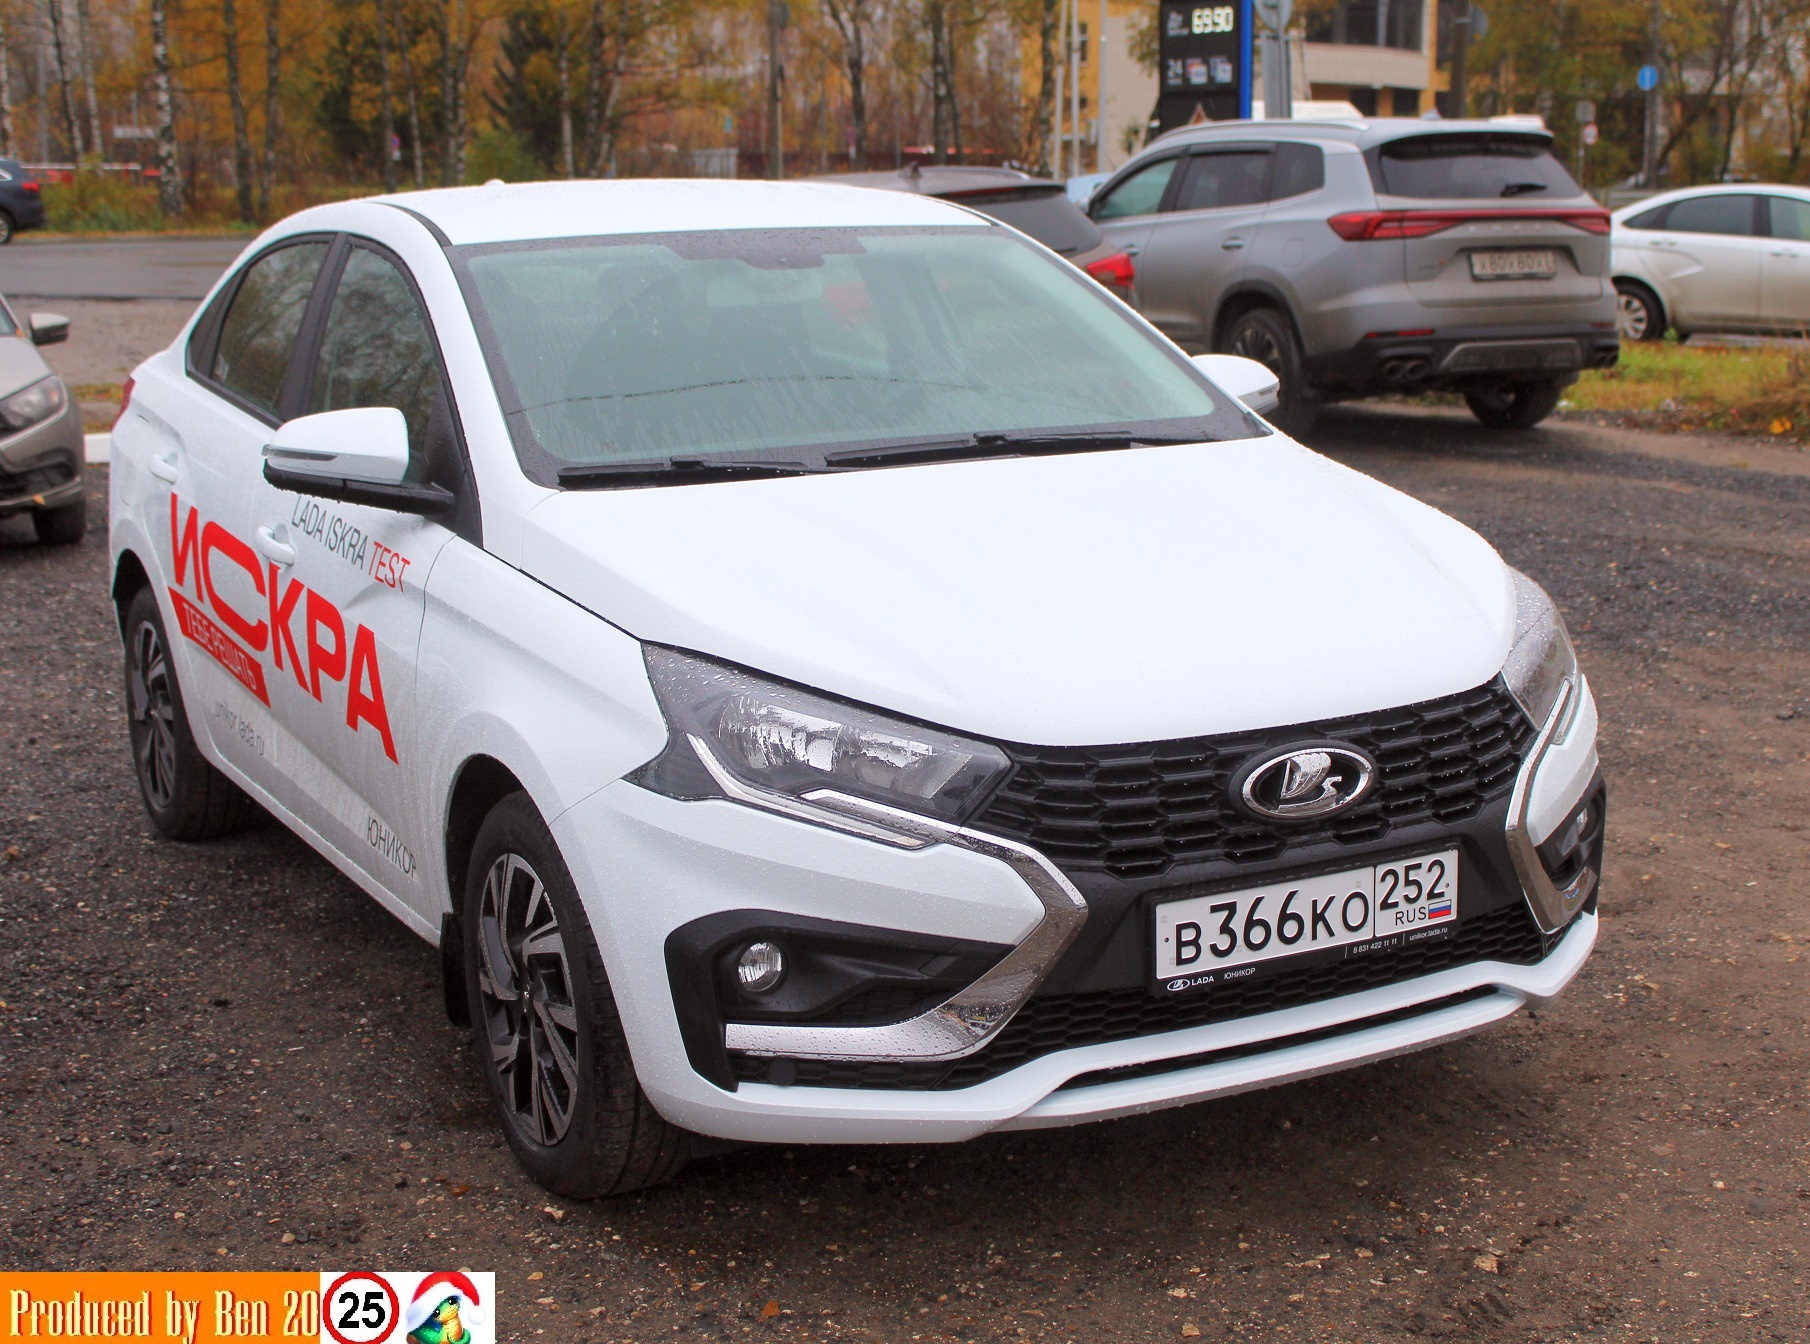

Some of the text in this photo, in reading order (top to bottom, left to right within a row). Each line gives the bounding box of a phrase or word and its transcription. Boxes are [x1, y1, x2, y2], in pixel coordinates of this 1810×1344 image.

[291, 495, 411, 593] LADA ISKRA TEST
[170, 492, 399, 766] ИСКРА
[182, 602, 257, 690] ТЕБЕ РЕШАТЬ
[367, 816, 417, 878] ЮНИКОР
[1379, 859, 1446, 911] 252
[1358, 944, 1369, 953] 831
[1370, 941, 1382, 950] 422
[1409, 927, 1448, 941] unikor.lada.ru
[1394, 907, 1427, 926] RUS
[1192, 967, 1256, 986] LADA ЮНИКОР
